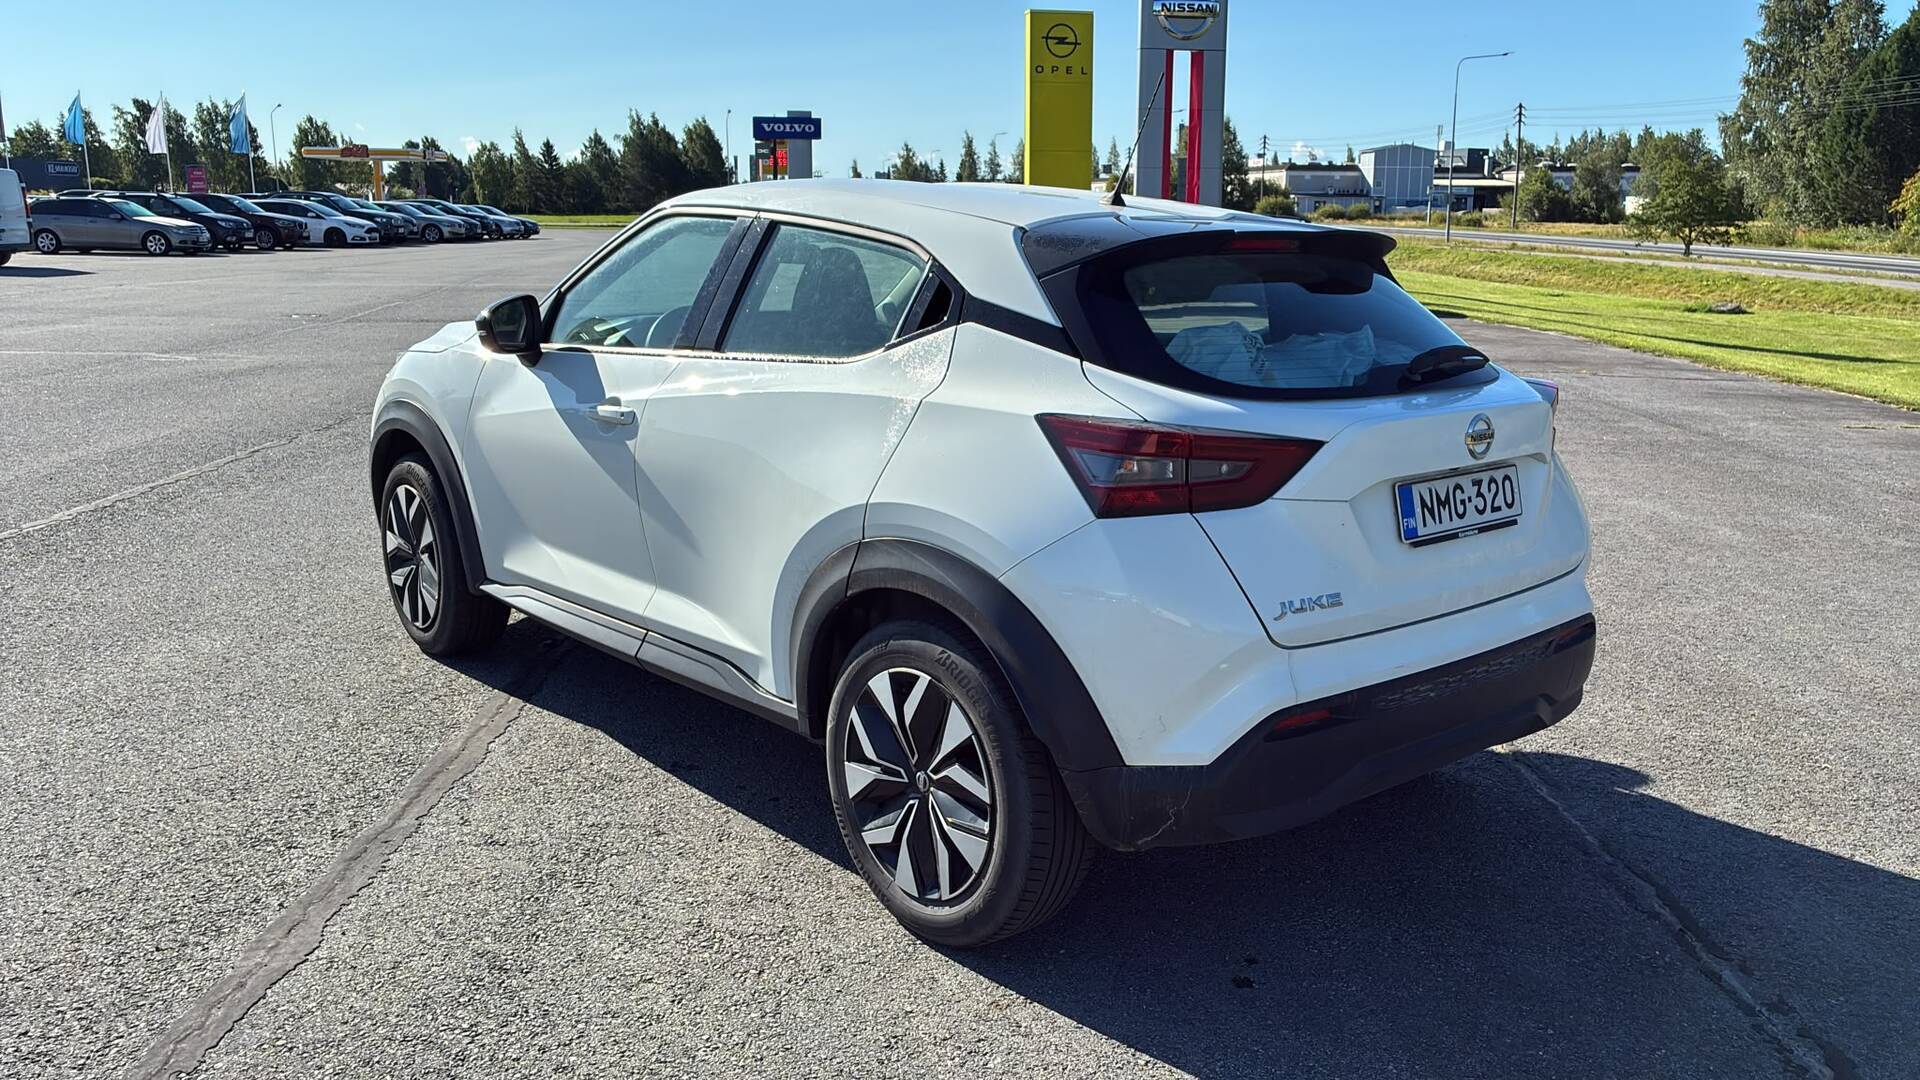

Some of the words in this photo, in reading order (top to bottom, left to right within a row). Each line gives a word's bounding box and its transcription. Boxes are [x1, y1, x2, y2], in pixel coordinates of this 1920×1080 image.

[1161, 2, 1214, 13] NISSAN
[1035, 65, 1088, 75] OPEL
[761, 123, 815, 133] VOLVO
[1470, 431, 1494, 442] NISSAN
[1418, 473, 1515, 528] NMG-320
[1403, 518, 1417, 529] FIN
[1273, 592, 1344, 621] JUKE
